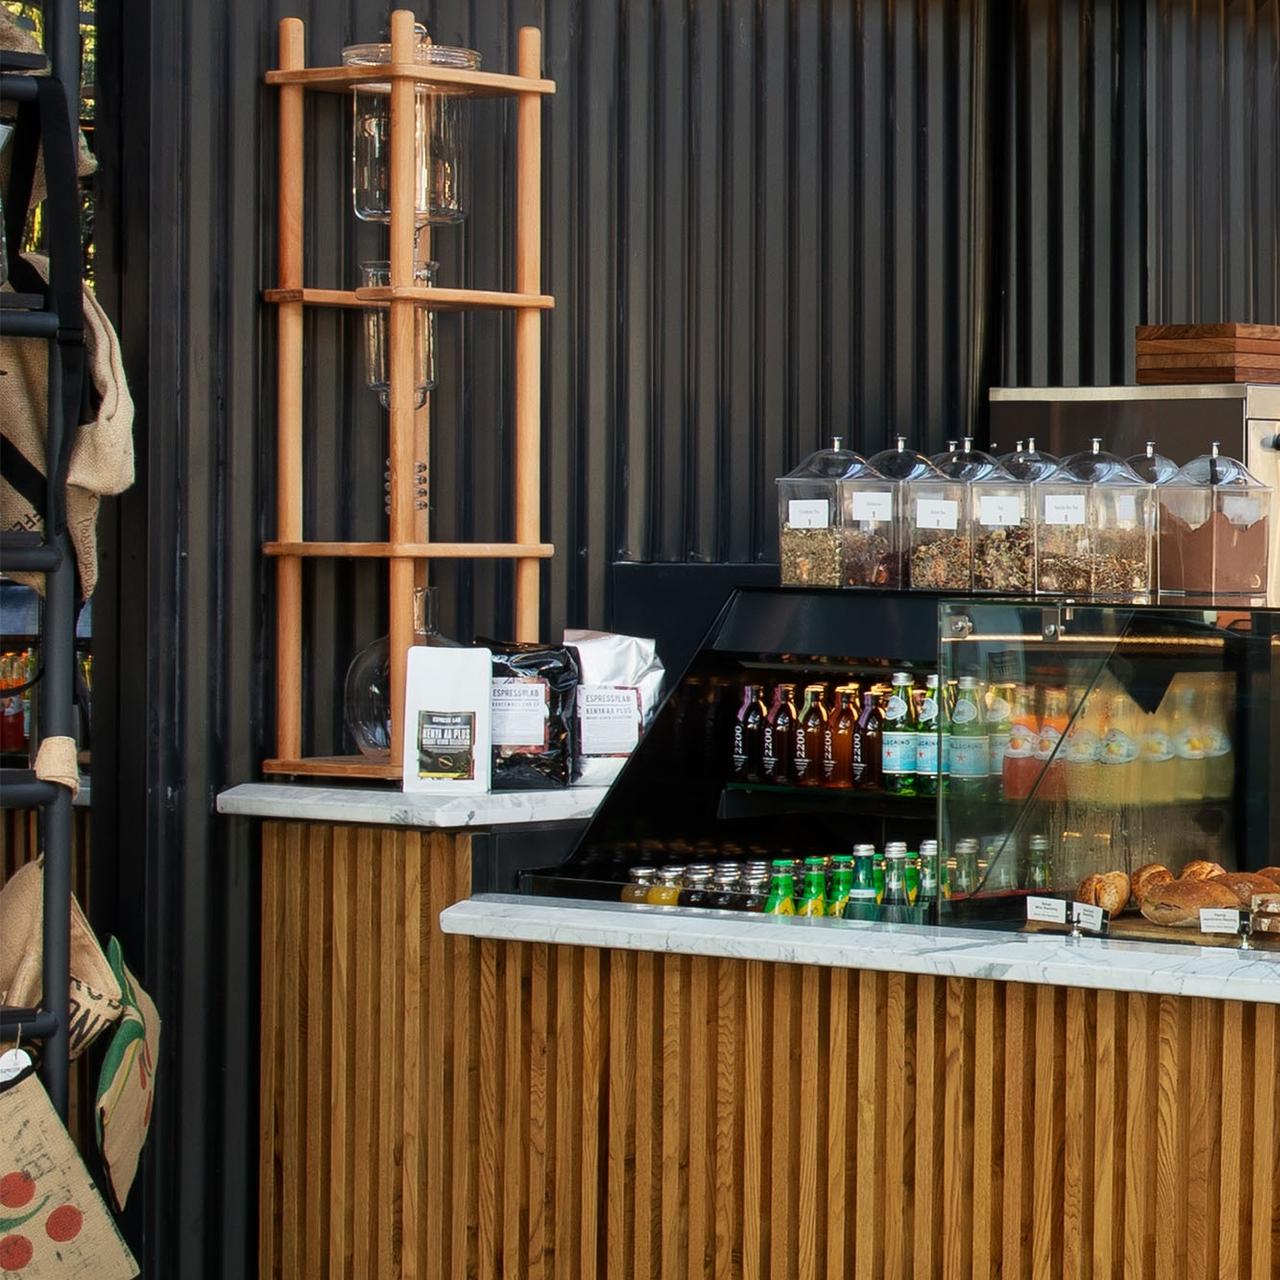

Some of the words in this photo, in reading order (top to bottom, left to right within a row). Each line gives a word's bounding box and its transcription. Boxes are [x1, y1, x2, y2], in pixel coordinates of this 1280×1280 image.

[734, 725, 742, 754] 2200
[764, 728, 773, 757] 2200
[796, 729, 805, 758] 2200
[824, 730, 832, 759] 2200
[853, 733, 862, 762] 2200
